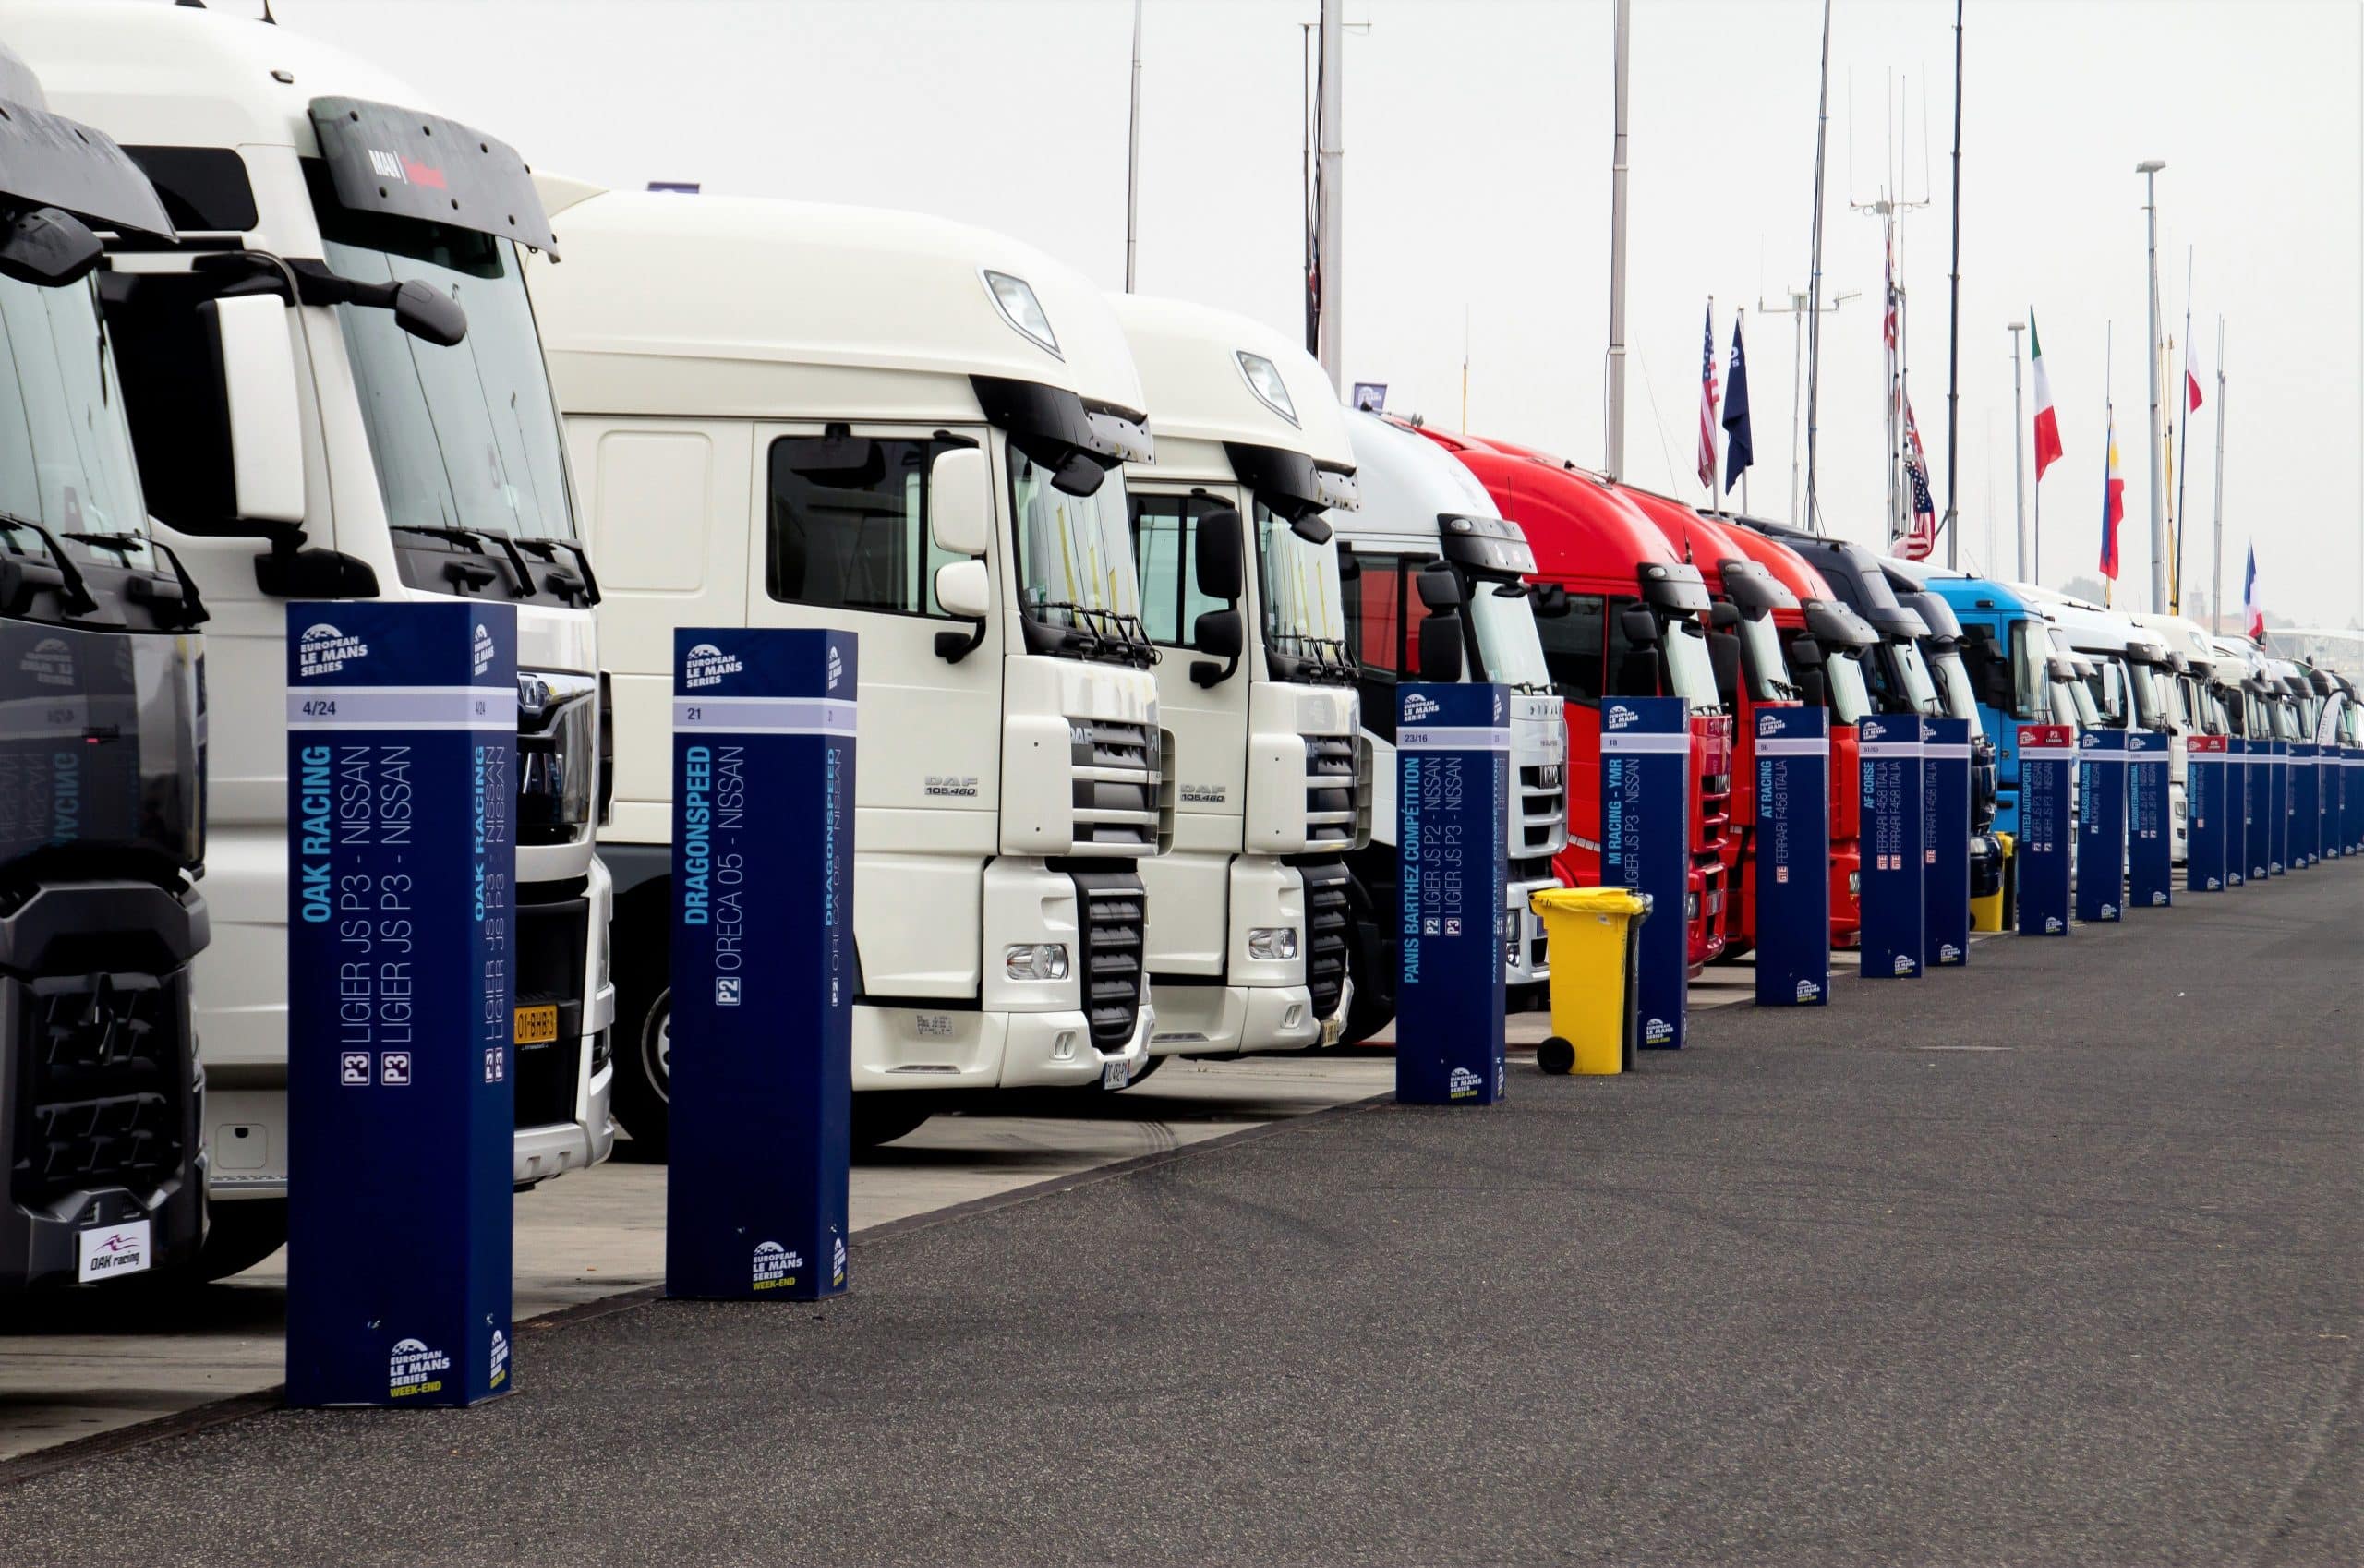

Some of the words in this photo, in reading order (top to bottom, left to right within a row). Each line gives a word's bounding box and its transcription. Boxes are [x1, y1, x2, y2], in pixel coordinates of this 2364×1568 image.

[368, 150, 401, 178] MAN
[301, 636, 359, 653] EUROPEAN
[301, 653, 317, 666] LE
[322, 645, 368, 662] MANS
[301, 661, 343, 677] SERIES
[687, 655, 735, 668] EUROPEAN
[687, 668, 700, 678] LE
[705, 661, 742, 676] MANS
[687, 675, 721, 688] SERIES
[303, 701, 336, 716] 4/24
[687, 707, 702, 720] 21
[1416, 705, 1440, 714] MANS
[1405, 734, 1428, 743] 23/16
[718, 746, 744, 829] NISSAN
[924, 776, 978, 786] DAF
[1424, 757, 1441, 810] NISSAN
[1444, 757, 1462, 810] NISSAN
[1609, 759, 1622, 789] YMR
[1625, 758, 1640, 803] NISSAN
[1761, 760, 1772, 802] RACING
[1775, 760, 1787, 790] ITALIA
[1863, 761, 1874, 793] CORSE
[2023, 762, 2032, 812] AUTOSPORTS
[302, 746, 331, 855] RACING
[341, 746, 370, 844] NISSAN
[381, 746, 411, 844] NISSAN
[475, 746, 484, 854] RACING
[1180, 784, 1226, 794] DAF
[1401, 757, 1419, 861] COMPÉTITION
[1761, 804, 1773, 818] AT
[1776, 792, 1788, 820] F458
[1863, 799, 1874, 809] AF
[685, 745, 711, 925] DRAGONSPEED
[826, 748, 835, 926] DRAGONSPEED
[1424, 825, 1441, 845] P2
[1444, 825, 1462, 845] P3
[1609, 801, 1622, 850] RACING
[1625, 815, 1639, 832] P3
[2022, 814, 2031, 842] UNITED
[1625, 835, 1639, 850] JS
[1776, 822, 1788, 864] FERRARI
[717, 852, 743, 886] 05
[1424, 849, 1441, 867] JS
[1444, 849, 1462, 867] JS
[1609, 853, 1622, 864] M
[302, 862, 331, 923] OAK
[341, 874, 370, 910] P3
[381, 874, 411, 910] P3
[475, 862, 484, 922] OAK
[1405, 864, 1419, 935] BARTHEZ
[1424, 871, 1441, 913] LIGIER
[1444, 871, 1462, 913] LIGIER
[341, 920, 370, 953] JS
[381, 920, 411, 953] JS
[716, 892, 742, 971] ORECA
[1426, 919, 1439, 935] P2
[1447, 919, 1460, 935] P3
[1405, 938, 1419, 983] PANIS
[341, 962, 370, 1043] LIGIER
[381, 962, 411, 1043] LIGIER
[718, 978, 740, 1004] P2
[342, 1054, 369, 1083] P3
[382, 1054, 410, 1083] P3
[1461, 1078, 1481, 1086] MANS
[754, 1251, 796, 1263] EUROPEAN
[754, 1262, 765, 1272] LE
[768, 1258, 802, 1271] MANS
[754, 1270, 783, 1282] SERIES
[754, 1277, 795, 1290] WEEK-END
[391, 1350, 442, 1365] EUROPEAN
[391, 1365, 404, 1377] LE
[409, 1357, 450, 1374] MANS
[391, 1373, 428, 1387] SERIES
[391, 1381, 442, 1398] WEEK-END
